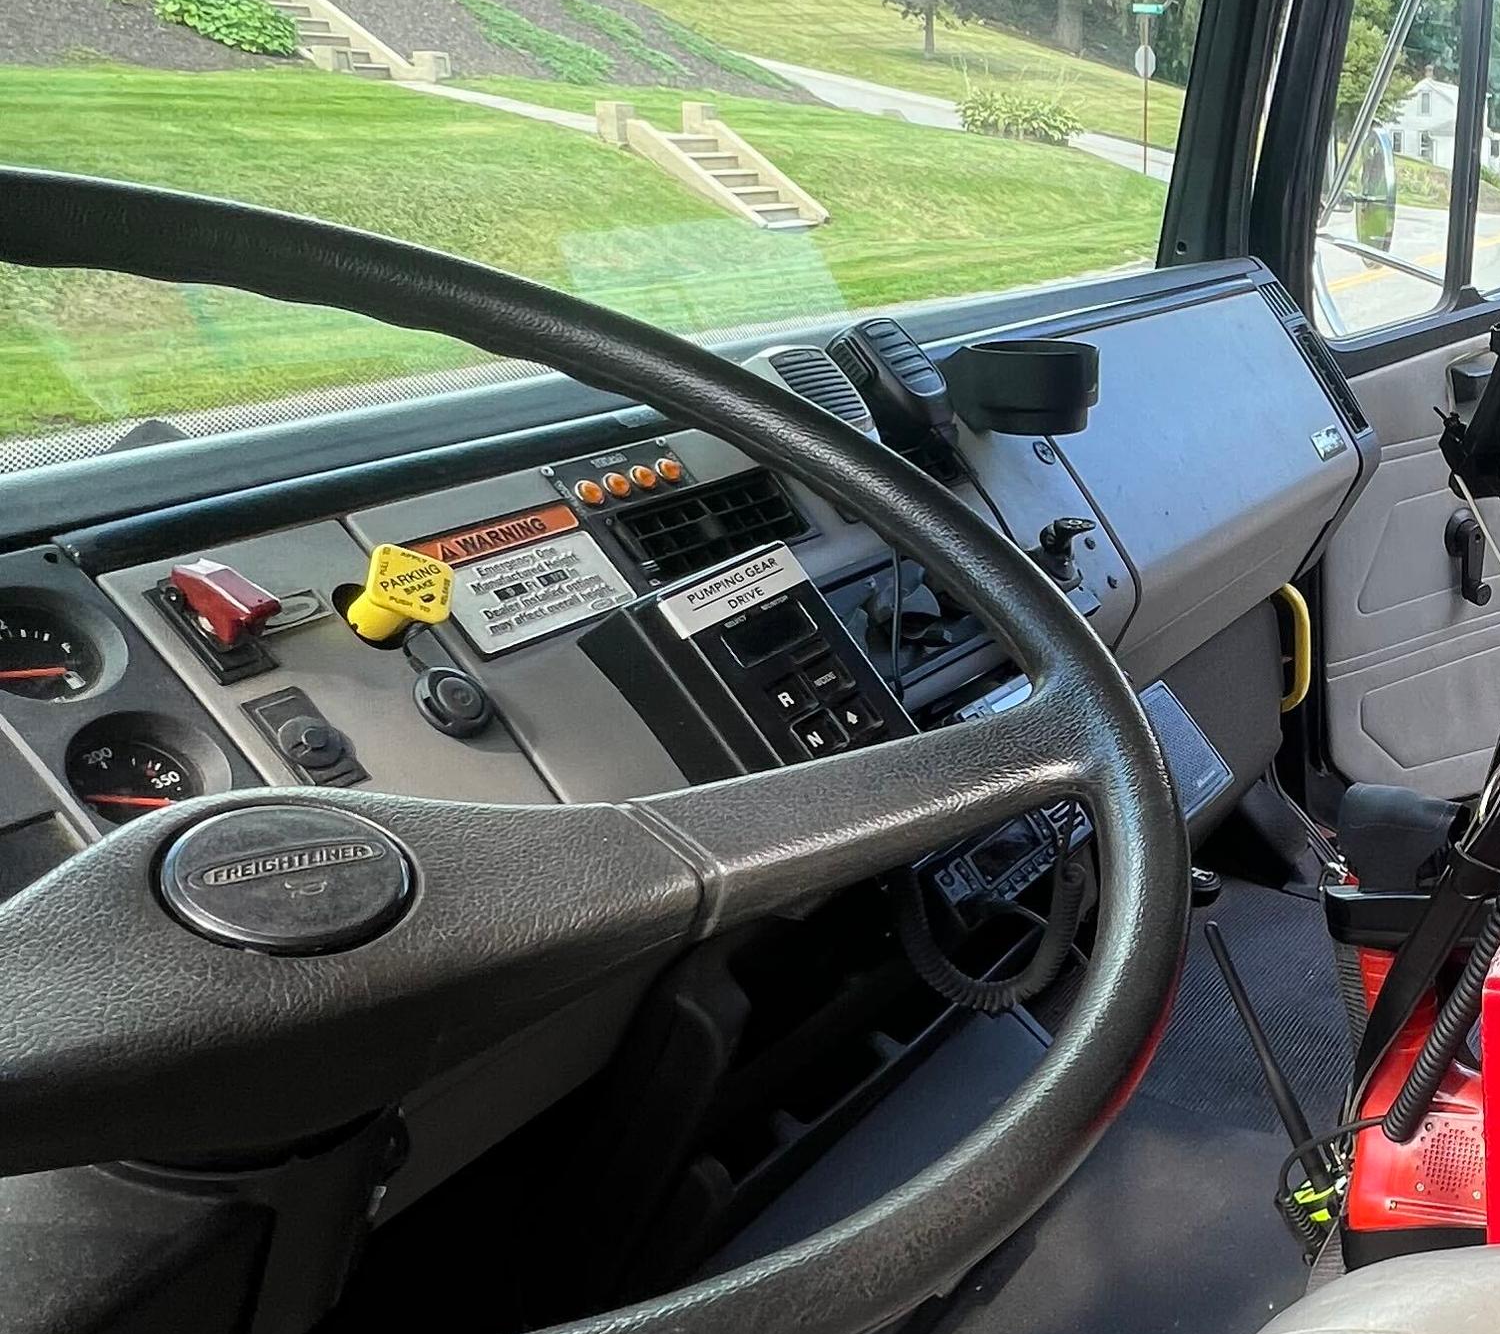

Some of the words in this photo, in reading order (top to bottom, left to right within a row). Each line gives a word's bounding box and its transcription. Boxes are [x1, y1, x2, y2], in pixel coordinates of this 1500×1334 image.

[456, 518, 547, 554] WARNING
[470, 564, 545, 595] Manufactured
[544, 553, 580, 569] Height
[476, 554, 535, 577] Emergency
[535, 547, 556, 558] One
[380, 564, 441, 592] PARKING
[403, 579, 437, 595] BRAKE
[686, 572, 745, 605] PUMPING
[745, 557, 779, 579] GEAR
[483, 602, 521, 620] Dealer
[728, 586, 765, 610] DRIVE
[489, 620, 513, 634] may
[514, 607, 547, 625] affect
[547, 593, 582, 613] overall
[777, 692, 795, 708] R
[806, 731, 825, 748] N
[83, 747, 113, 765] 200
[150, 770, 181, 789] 350
[213, 846, 367, 882] FREIGHTLINER
